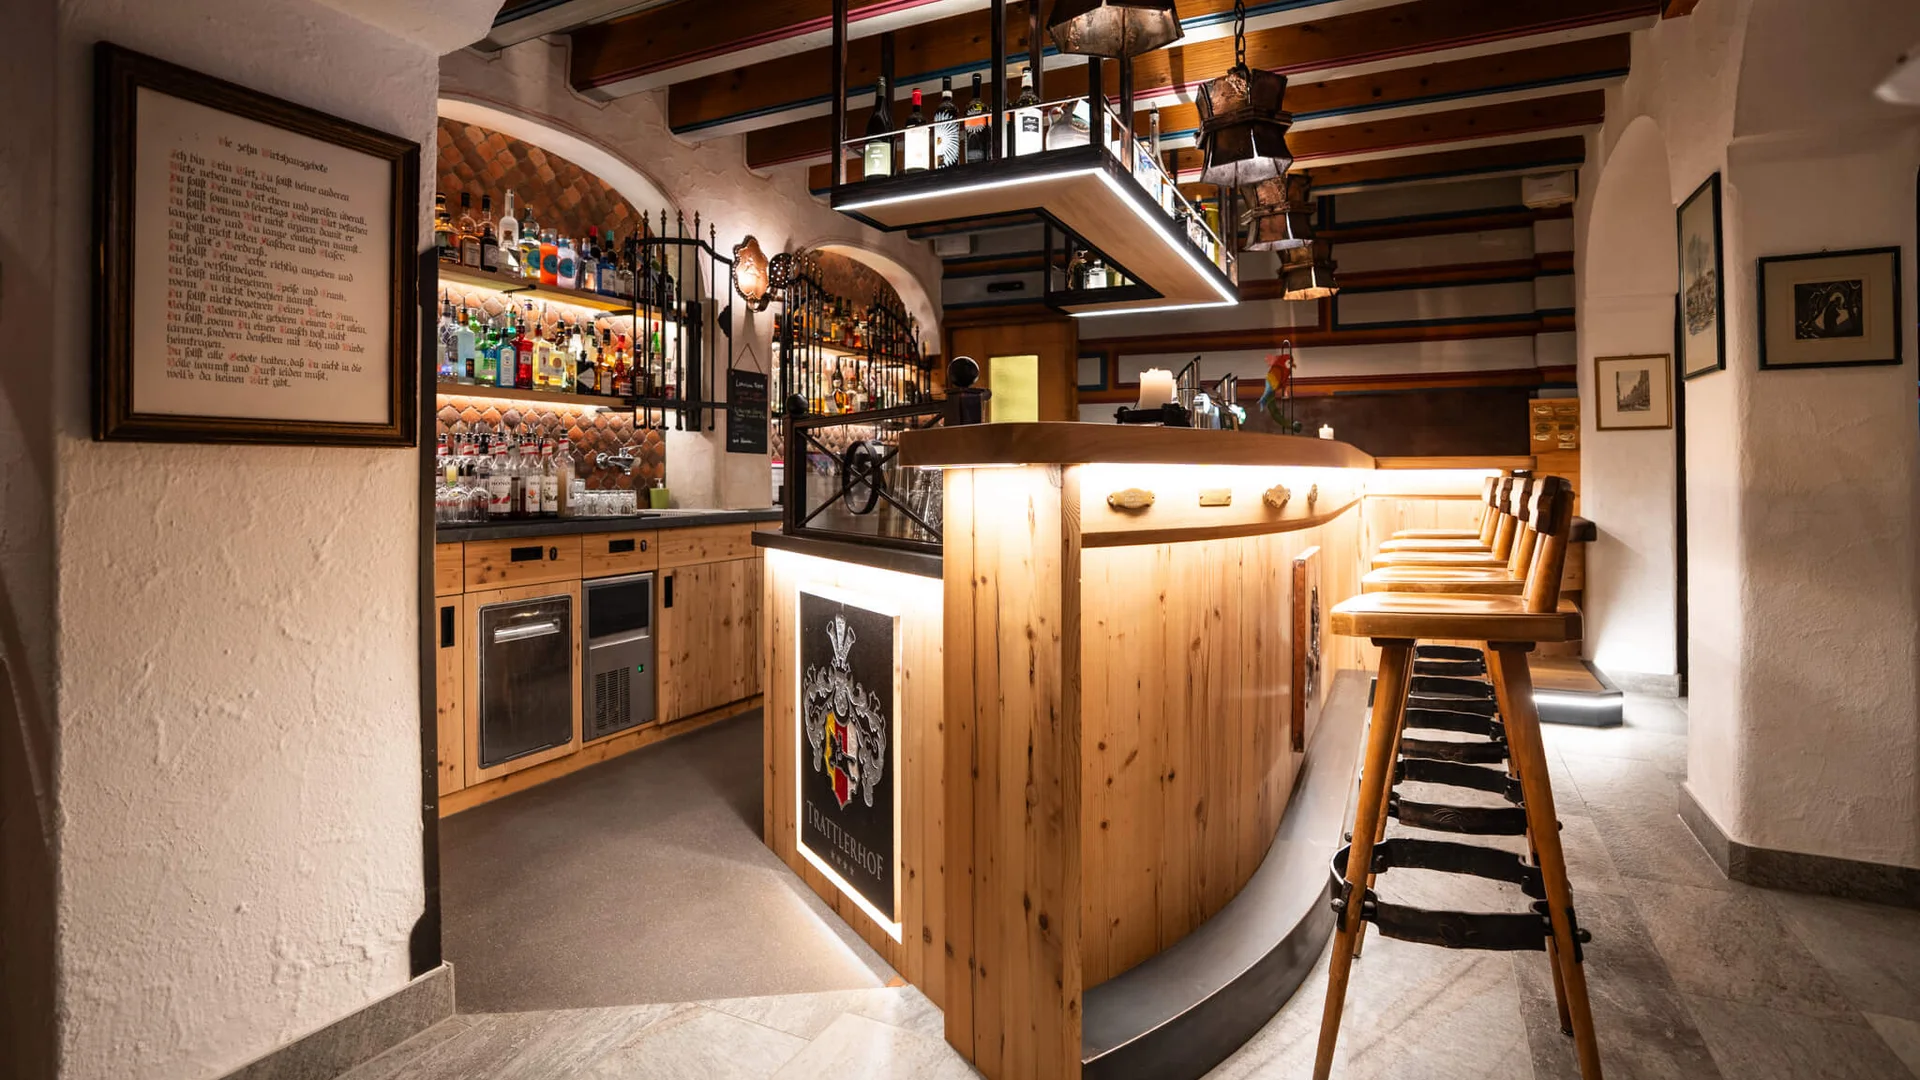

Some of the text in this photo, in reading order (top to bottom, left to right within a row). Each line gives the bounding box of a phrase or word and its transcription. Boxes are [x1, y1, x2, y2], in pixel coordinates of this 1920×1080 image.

[237, 143, 257, 156] zehn
[170, 161, 195, 175] Wirte
[200, 170, 226, 182] neben
[231, 176, 248, 187] mir
[189, 153, 204, 166] bin
[211, 158, 231, 172] Dein
[261, 171, 272, 183] Du
[275, 175, 293, 188] sollst
[294, 181, 316, 193] keine
[318, 188, 349, 201] anderen
[169, 172, 183, 183] Du
[187, 176, 206, 189] sollst
[211, 181, 242, 196] Deinen
[246, 189, 264, 202] Wirt
[267, 196, 289, 208] ehren
[293, 202, 308, 212] und
[169, 184, 182, 194] Du
[186, 186, 206, 202] sollst
[209, 192, 228, 205] sonn
[232, 199, 249, 209] und
[251, 201, 288, 218] feiertags
[291, 211, 319, 224] Deinen
[321, 218, 336, 228] Wirt
[168, 206, 198, 224] lange
[201, 214, 220, 225] lebe
[225, 220, 243, 229] und
[248, 223, 259, 233] Du
[262, 227, 286, 240] lange
[170, 195, 182, 206] Du
[186, 197, 206, 212] sollst
[211, 204, 241, 218] Deinen
[243, 211, 261, 223] Wirt
[264, 217, 283, 228] nicht
[319, 227, 341, 240] damit
[168, 229, 189, 243] sonst
[194, 234, 221, 248] gibt's
[170, 219, 182, 230] Du
[185, 221, 205, 237] sollst
[209, 227, 230, 239] nicht
[234, 231, 256, 244] töten
[298, 245, 316, 255] und
[168, 254, 199, 267] nichts
[169, 241, 353, 283] Du sollst Deine eche richtig angeben und
[168, 265, 182, 276] Du
[186, 267, 205, 281] sollst
[209, 271, 230, 283] nicht
[302, 287, 318, 297] und
[168, 278, 196, 289] wenn
[205, 282, 217, 292] Du
[222, 285, 242, 296] nicht
[168, 288, 181, 299] Du
[186, 290, 206, 303] sollst
[209, 294, 231, 305] nicht
[278, 304, 304, 315] Deines
[309, 308, 333, 319] Wirtes
[167, 311, 180, 322] Du
[206, 318, 233, 327] wenn
[238, 319, 250, 330] Du
[253, 321, 274, 332] einen
[280, 325, 308, 337] Rausch
[328, 332, 345, 341] nicht
[250, 310, 262, 320] die
[300, 317, 327, 328] Deinem
[329, 321, 344, 331] Wirt
[207, 327, 242, 340] sondern
[286, 336, 299, 346] mit
[324, 342, 339, 351] und
[167, 345, 180, 356] Du
[185, 347, 203, 359] sollst
[206, 350, 223, 360] alle
[228, 351, 257, 363] Gebote
[289, 358, 304, 368] daß
[308, 358, 318, 369] Du
[321, 360, 338, 371] nicht
[351, 363, 361, 373] die
[167, 358, 190, 368] Hölle
[194, 362, 229, 372] kommst
[232, 364, 249, 373] und
[252, 365, 275, 376] Durst
[279, 367, 302, 378] leiden
[166, 369, 194, 380] weil's
[199, 370, 211, 381] da
[215, 373, 245, 384] keinen
[248, 376, 268, 386] Wirt
[806, 800, 884, 881] TRATTLERHOF
